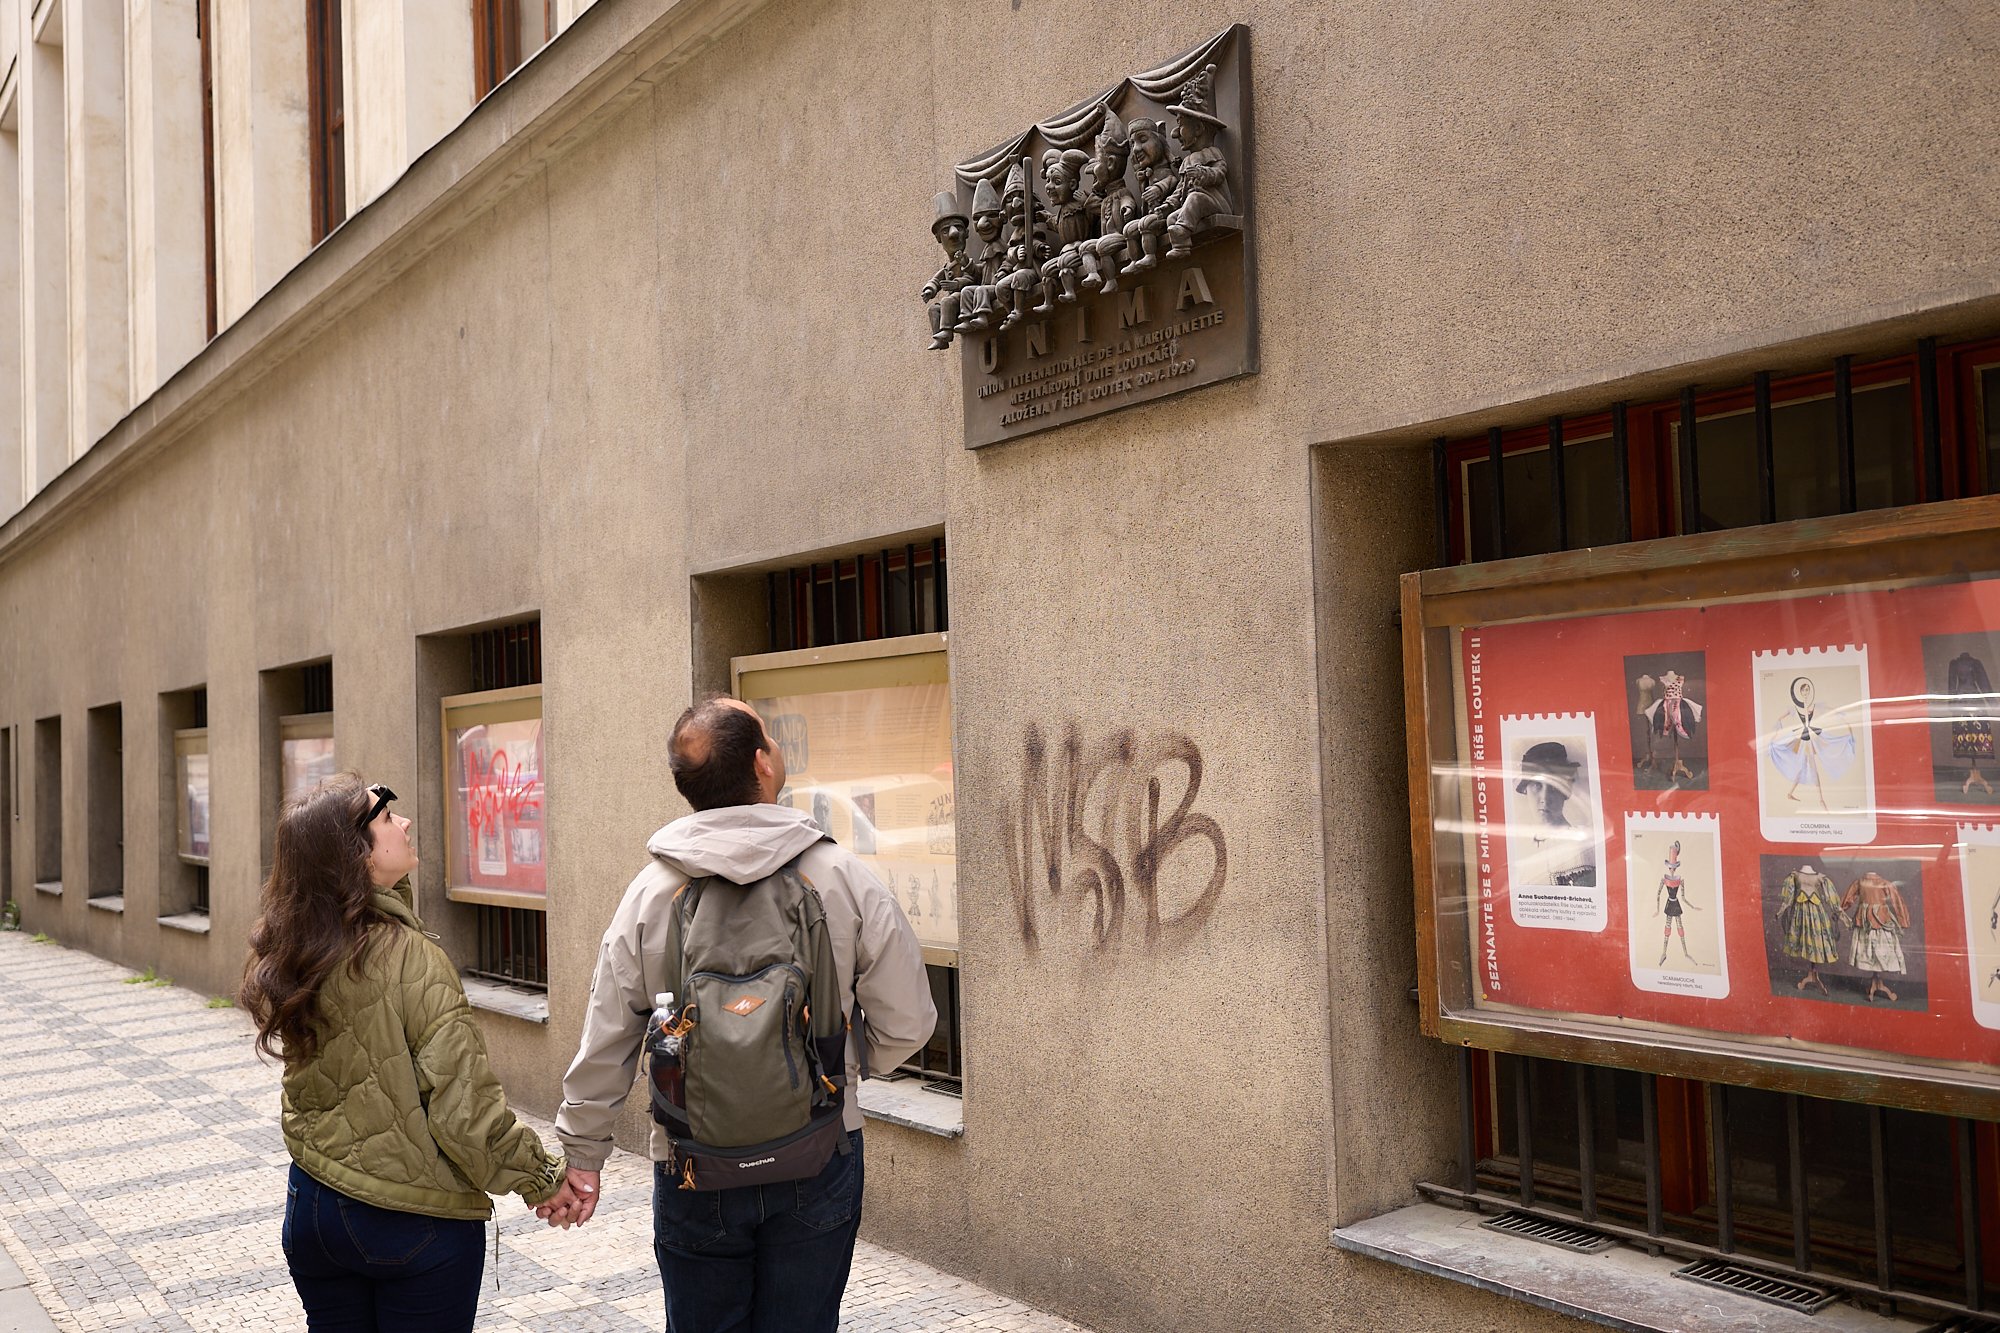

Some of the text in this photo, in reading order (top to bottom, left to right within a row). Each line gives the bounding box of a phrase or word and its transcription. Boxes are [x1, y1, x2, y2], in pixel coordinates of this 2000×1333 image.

[977, 310, 1224, 398] UNION INTERNATIONALE DE LA MARIONNETTE
[979, 267, 1214, 374] UNIMA
[1000, 404, 1050, 426] ZALOŽENA
[1088, 377, 1132, 400] LOUTEK
[1010, 339, 1178, 405] MEZINÁRODNÍ UNIE LOUTKÁŘŮ
[1471, 637, 1501, 990] SEZNAMTE SE S MINULOSTÍ ŘÍŠE LOUTEK II
[739, 1157, 775, 1168] Quechua
